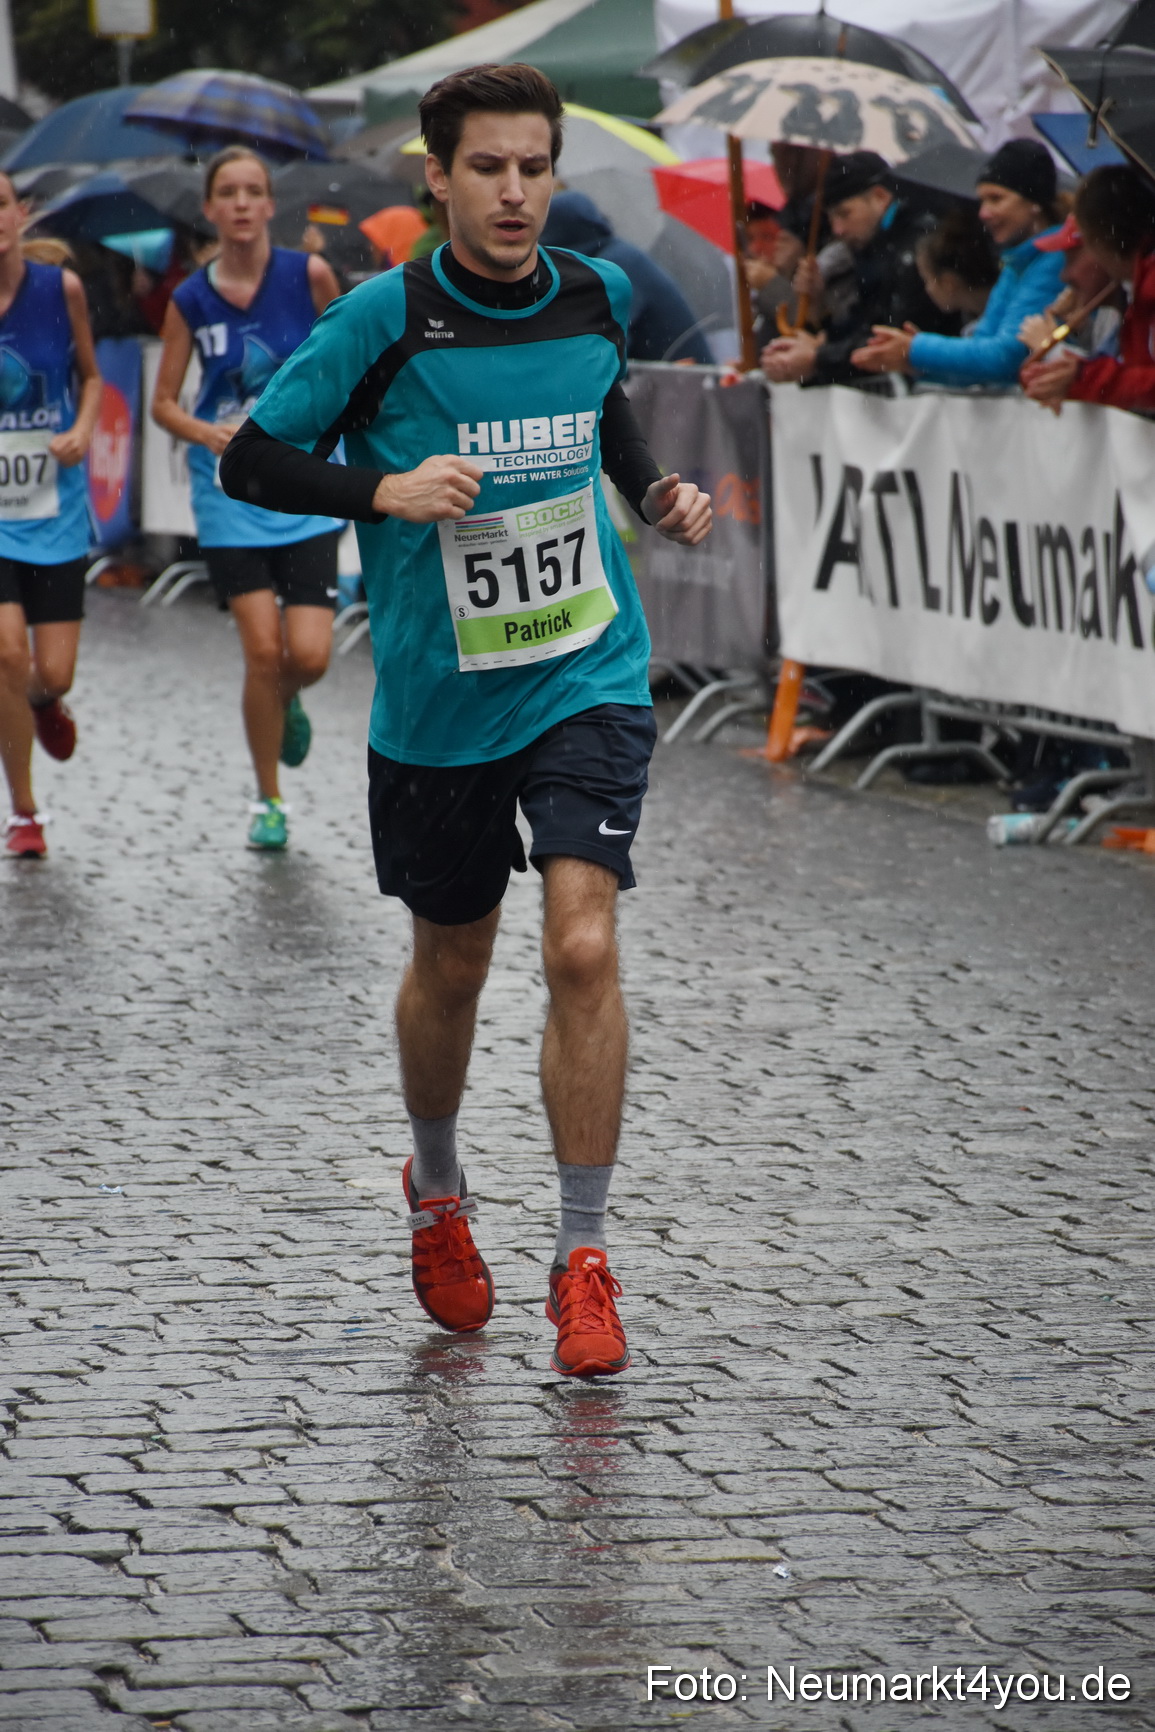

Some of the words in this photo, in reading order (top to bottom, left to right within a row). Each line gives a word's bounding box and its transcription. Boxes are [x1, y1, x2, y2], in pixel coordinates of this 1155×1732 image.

[424, 330, 455, 339] erima
[457, 411, 597, 454] HUBER
[492, 446, 590, 468] TECHNOLOGY
[493, 473, 528, 485] WASTE
[530, 470, 562, 482] WATER
[563, 465, 589, 478] Solutions
[515, 496, 585, 532] BOCK
[454, 529, 509, 542] NeuerMarkt
[464, 527, 585, 608] 5157
[458, 607, 466, 618] S
[504, 608, 573, 644] Patrick
